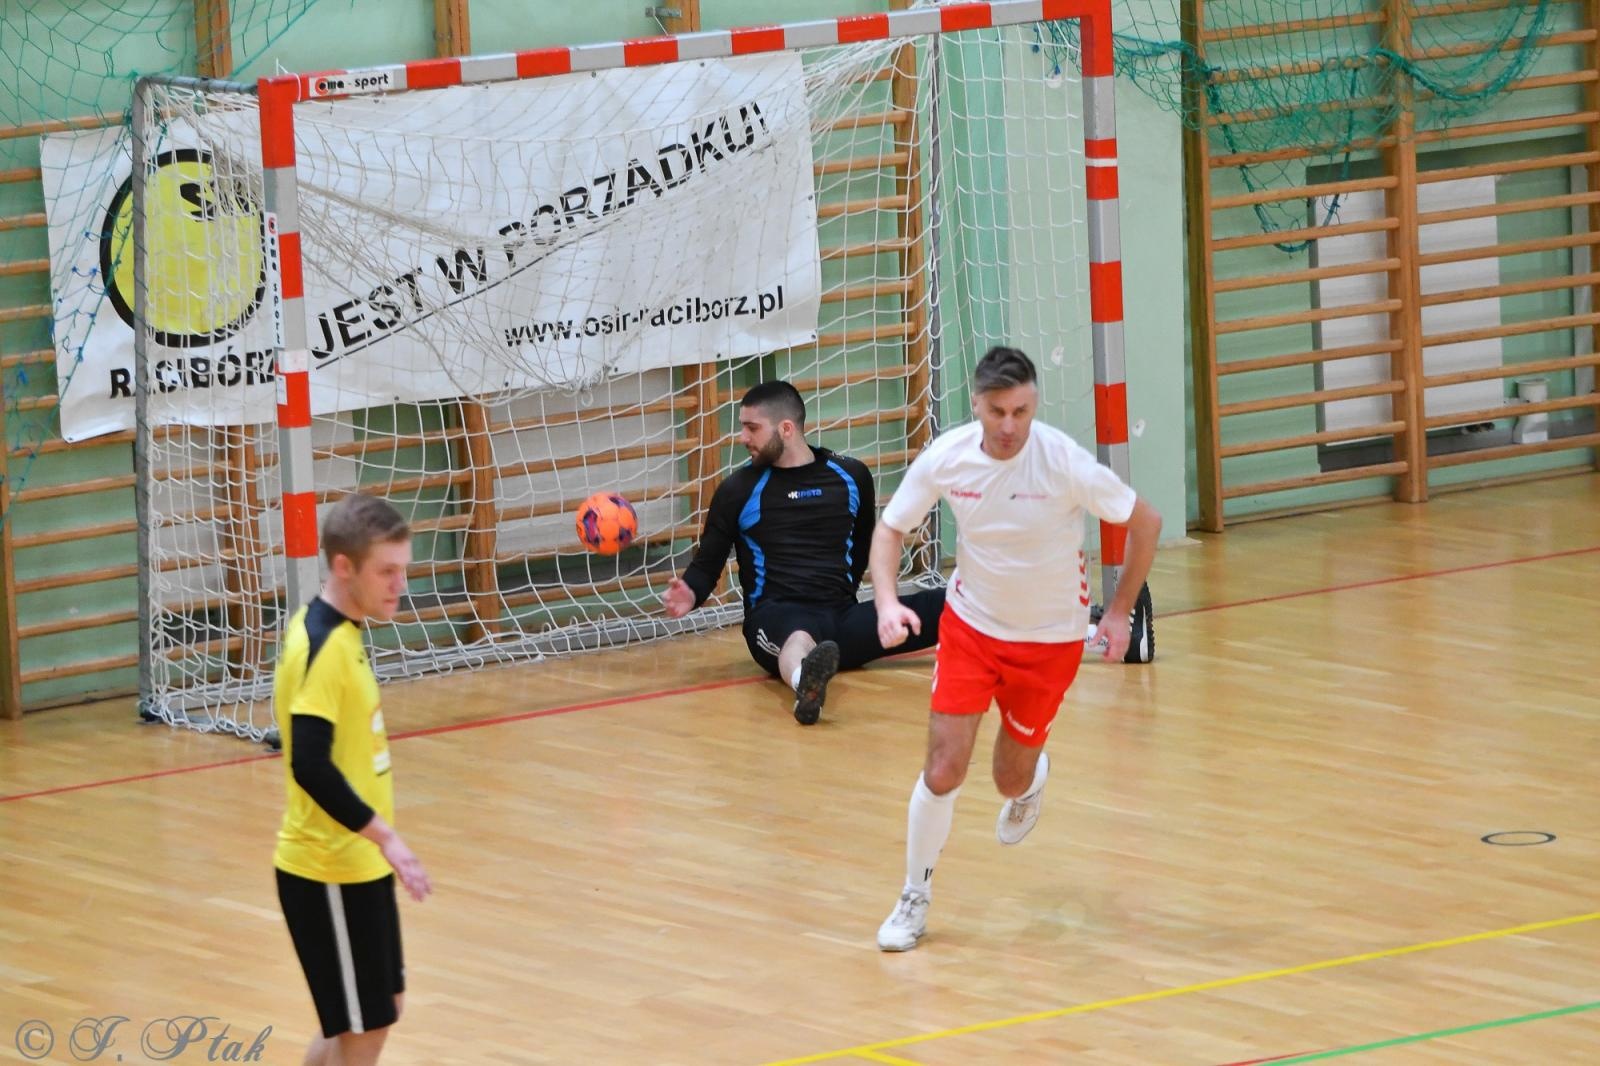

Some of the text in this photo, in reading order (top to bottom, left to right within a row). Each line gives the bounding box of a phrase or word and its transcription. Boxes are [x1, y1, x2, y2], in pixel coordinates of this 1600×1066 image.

[354, 73, 388, 89] sport
[110, 346, 274, 398] RCIBÓRZ
[311, 266, 423, 359] JEST
[435, 247, 488, 294] W
[504, 286, 784, 347] www.osir-raciborz.pl
